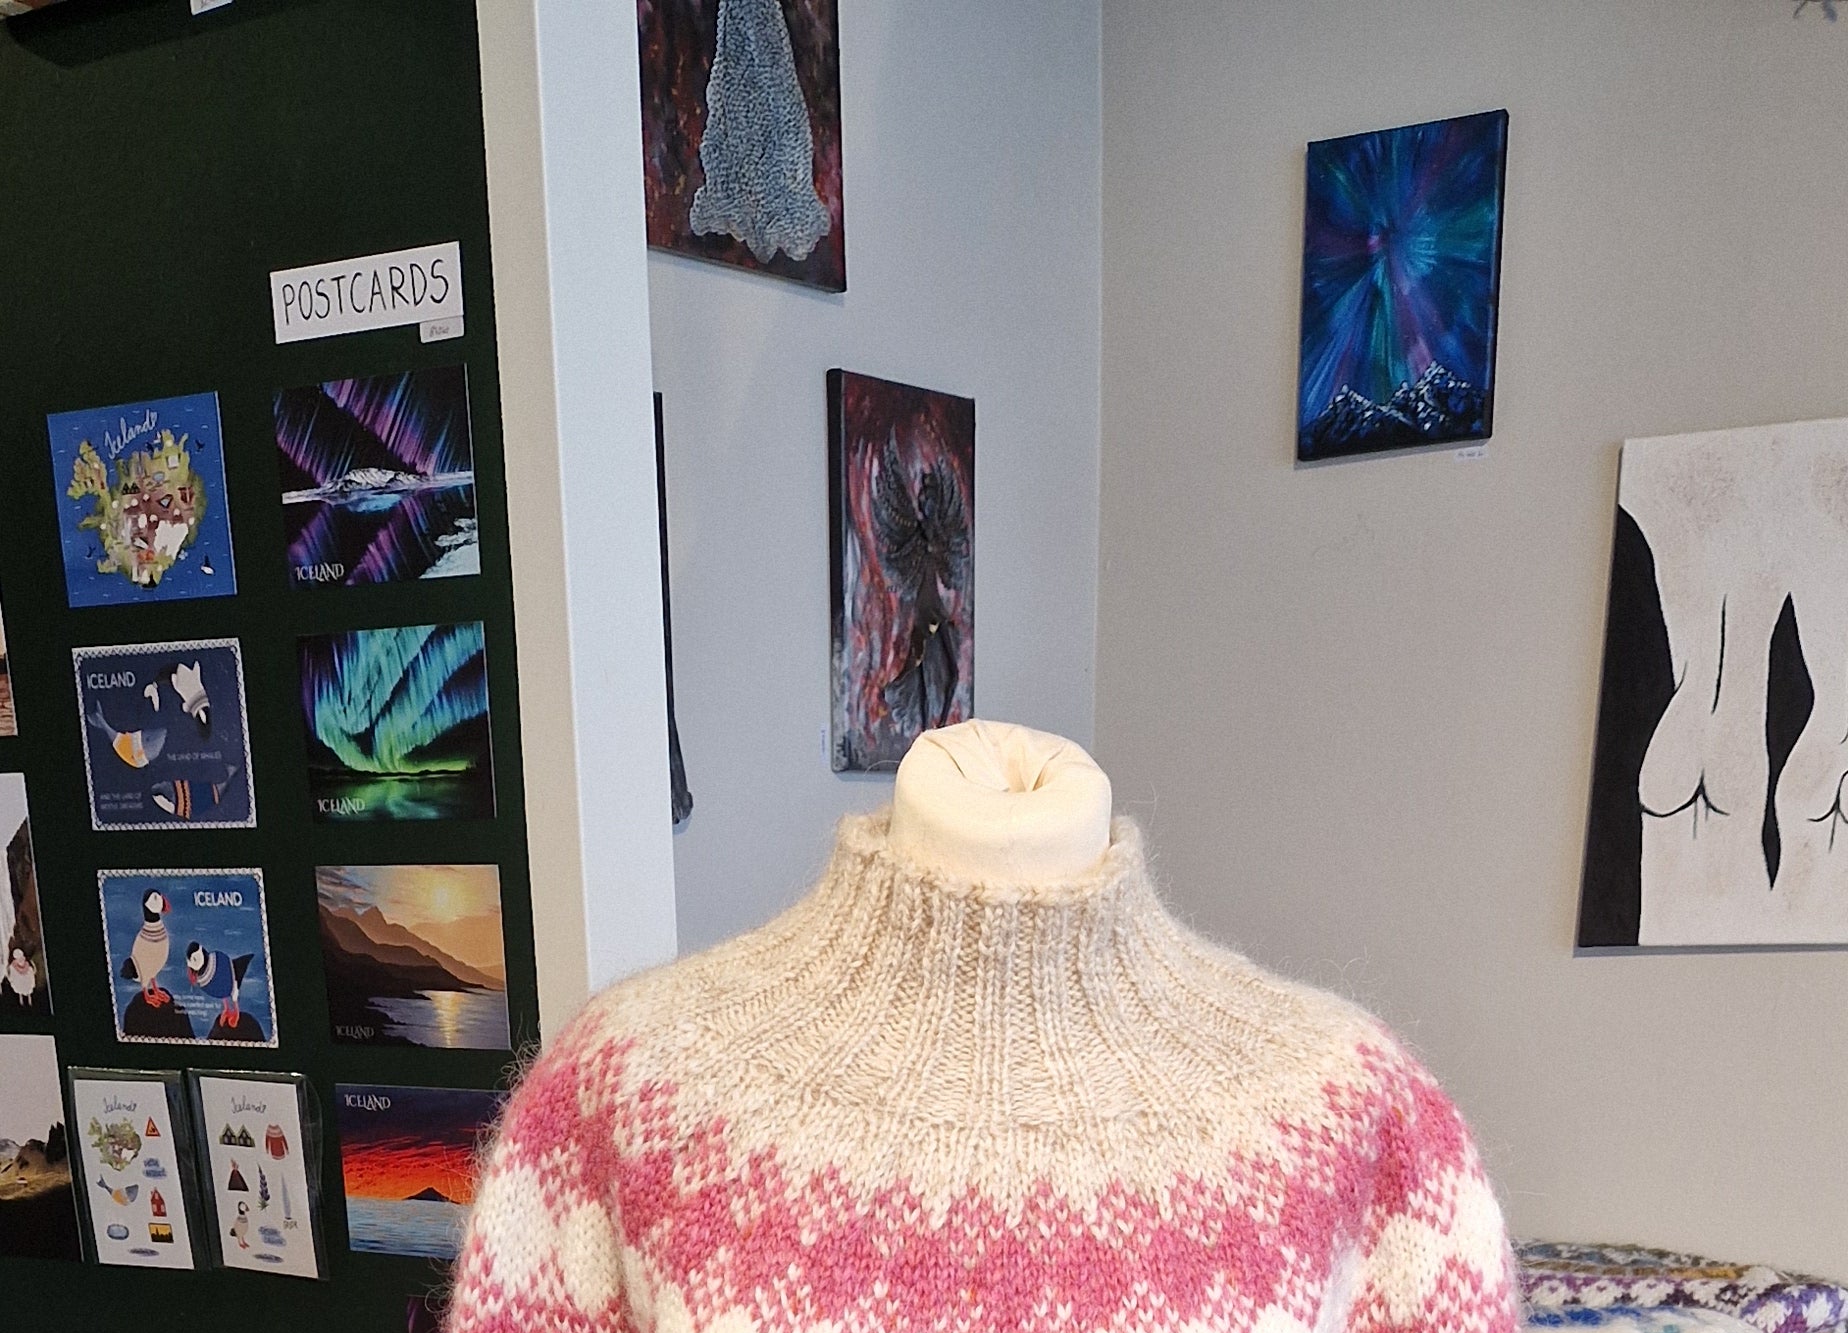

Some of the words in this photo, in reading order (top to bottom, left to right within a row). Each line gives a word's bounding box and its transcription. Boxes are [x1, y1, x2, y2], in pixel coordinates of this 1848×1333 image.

[282, 259, 449, 325] POSTCARDS
[105, 409, 158, 459] Iceland
[295, 562, 344, 582] ICELAND
[87, 671, 136, 689] ICELAND
[317, 796, 366, 815] ICELAND
[193, 891, 243, 907] ICELAND
[335, 1025, 375, 1039] ICELAND
[344, 1094, 391, 1111] ICELAND
